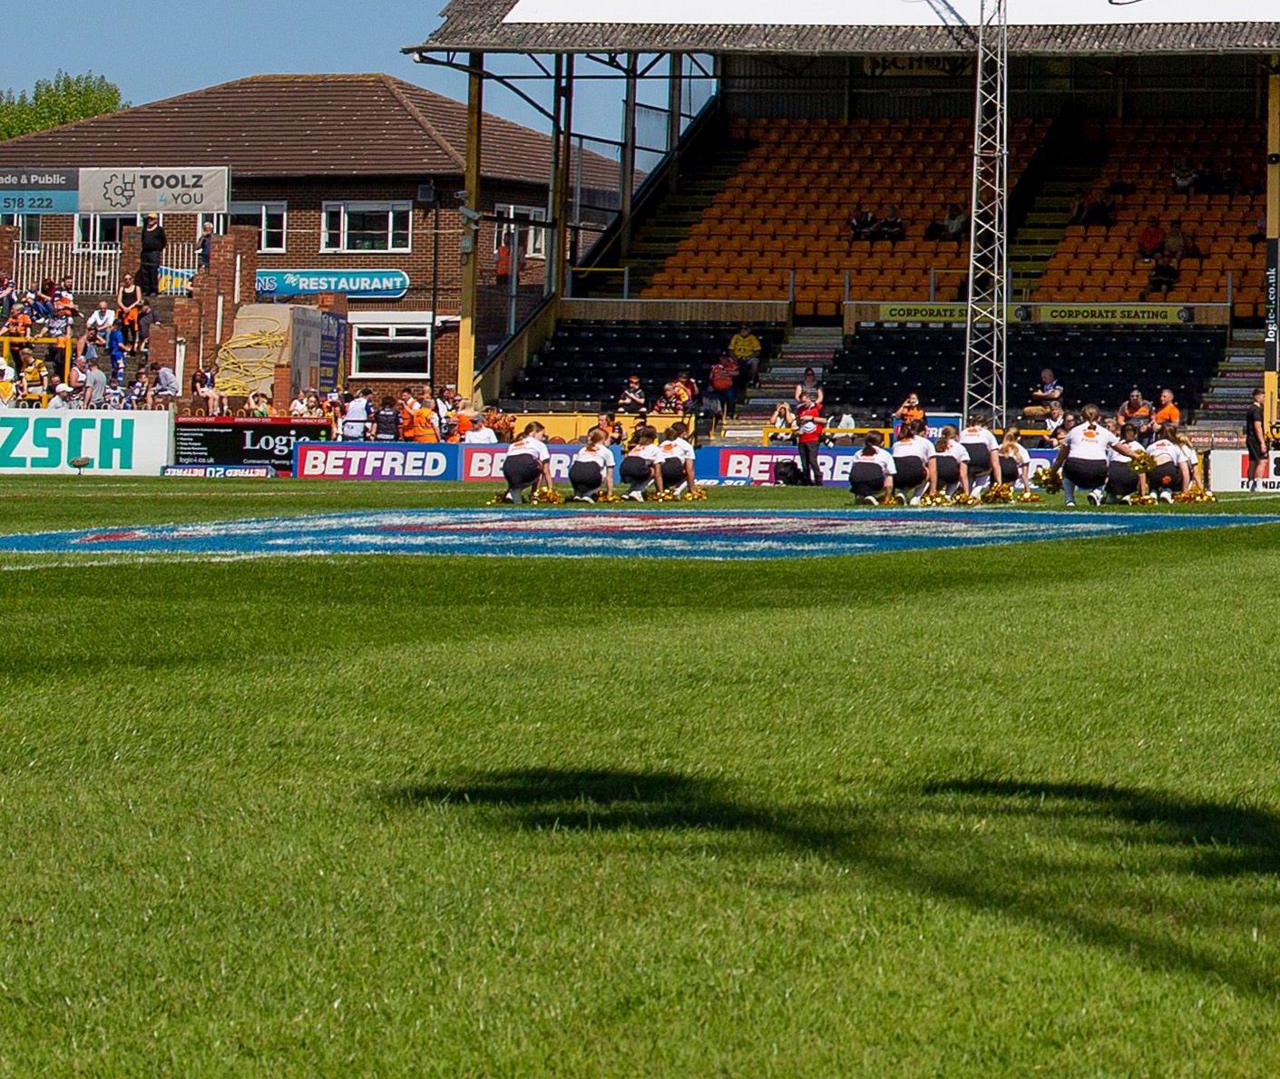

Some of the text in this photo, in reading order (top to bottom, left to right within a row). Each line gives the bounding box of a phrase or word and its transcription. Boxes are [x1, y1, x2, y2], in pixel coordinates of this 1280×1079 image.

[0, 174, 66, 185] ade & Public
[139, 174, 204, 189] TOOLZ
[3, 198, 53, 209] 518 222
[158, 193, 204, 205] 4 YOU
[256, 277, 277, 291] NS
[301, 277, 403, 290] RESTAURANT
[1264, 267, 1277, 342] logic-i.co.uk
[889, 308, 955, 318] CORPORATE
[1050, 309, 1168, 320] CORPORATE SEATING
[0, 417, 135, 469] ZSCH
[303, 450, 447, 476] BETFRED
